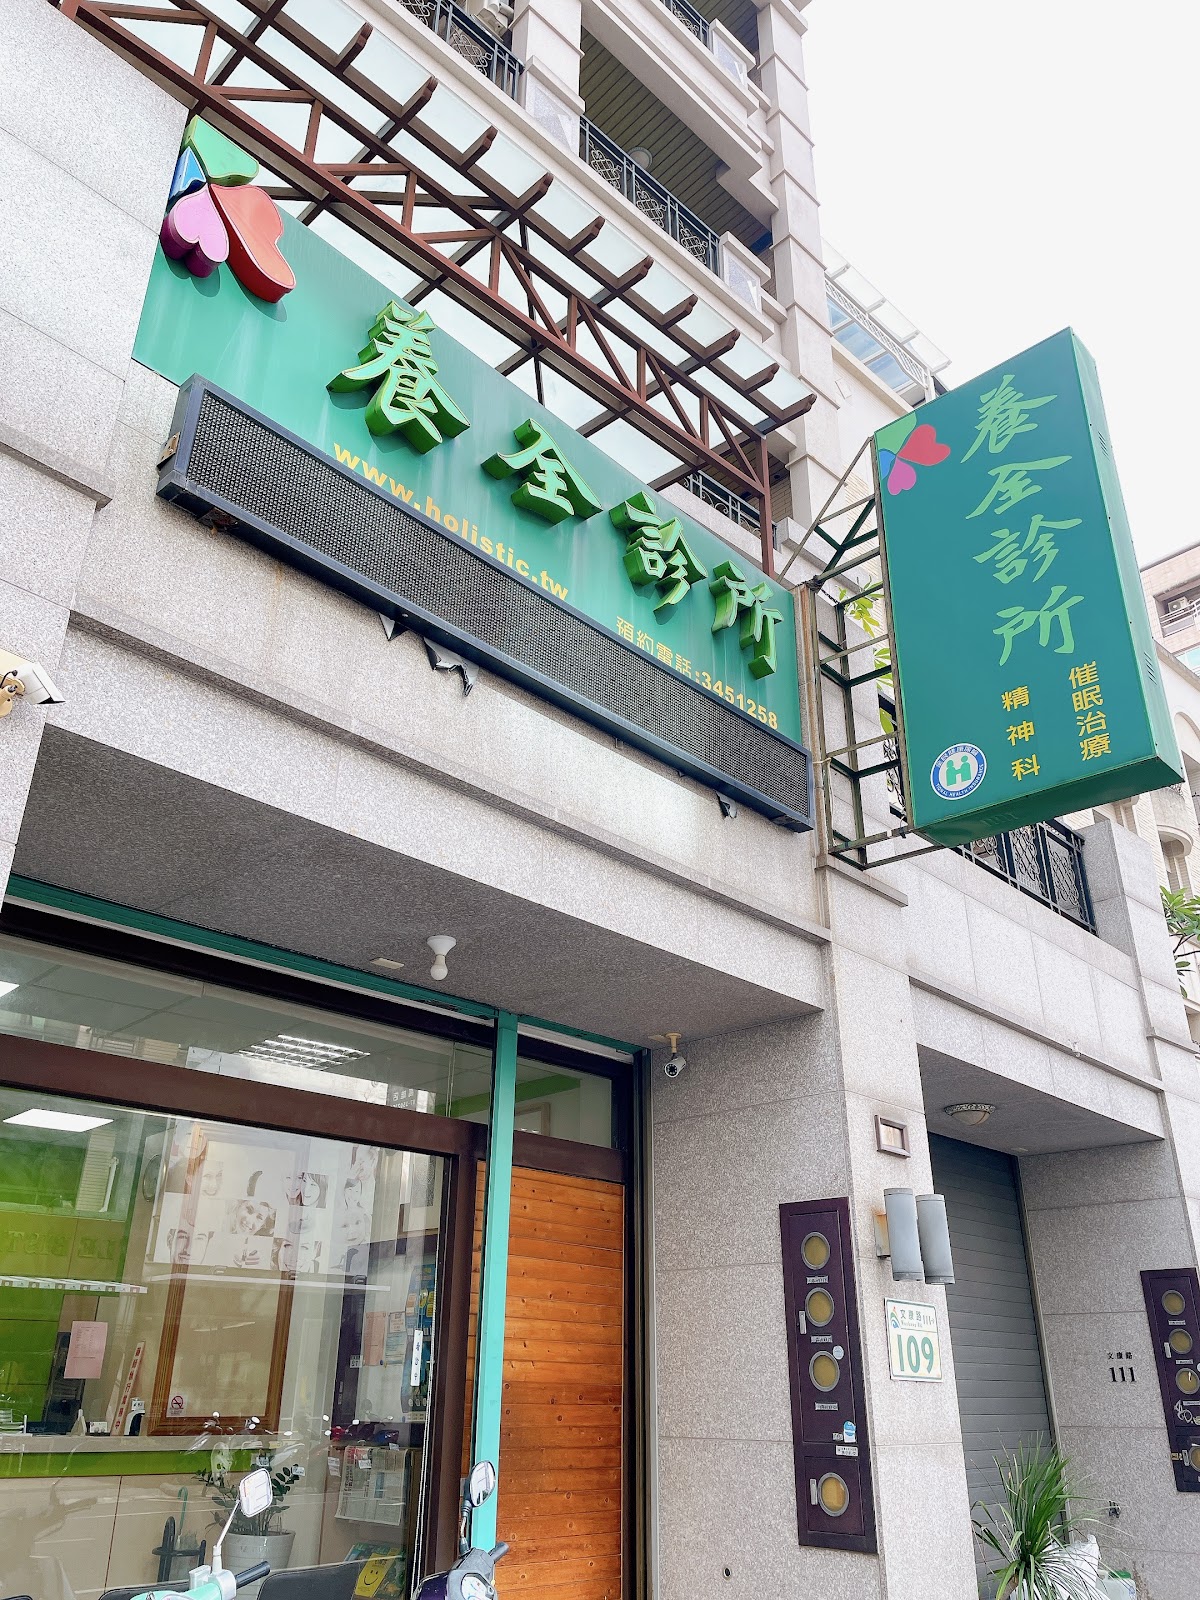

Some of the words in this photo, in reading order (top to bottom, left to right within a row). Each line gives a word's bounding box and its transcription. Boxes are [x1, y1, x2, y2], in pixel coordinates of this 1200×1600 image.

[327, 301, 783, 679] 養全診所
[334, 442, 569, 601] www.holistic.tw
[961, 375, 1084, 666] 養全診所
[1001, 685, 1041, 781] 精神科
[1069, 661, 1111, 761] 催眠治療
[897, 1334, 934, 1374] 109
[1109, 1366, 1137, 1382] 111
